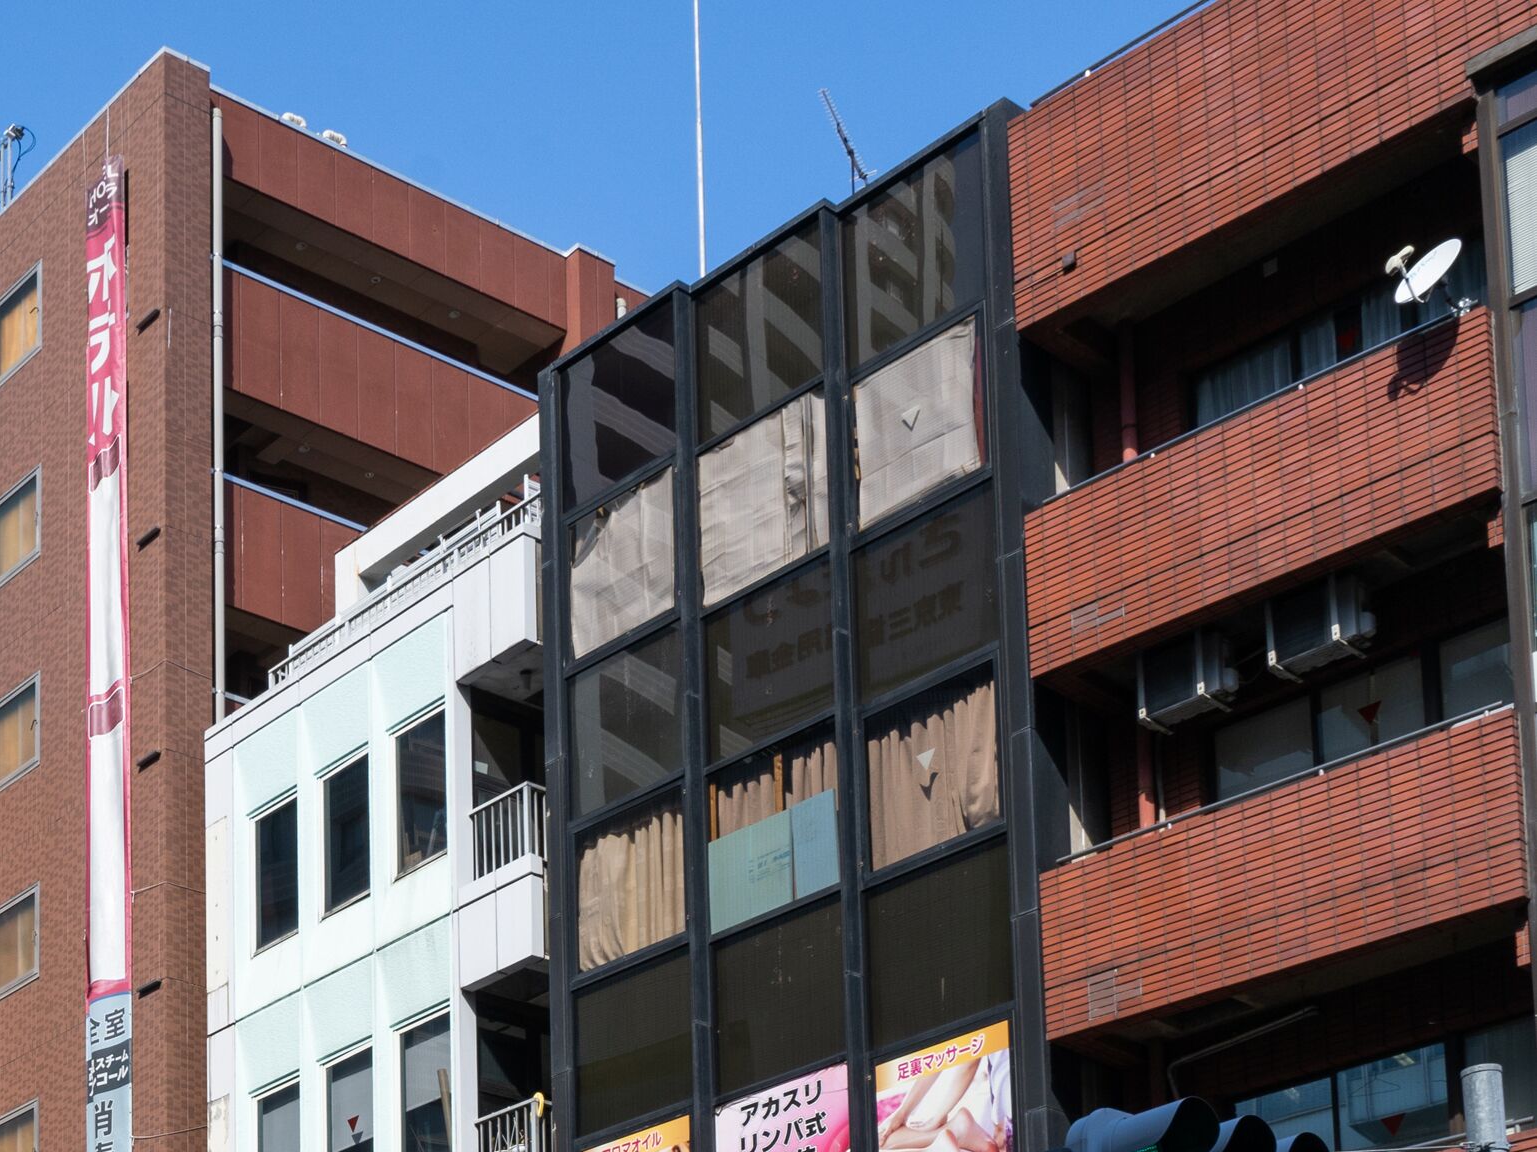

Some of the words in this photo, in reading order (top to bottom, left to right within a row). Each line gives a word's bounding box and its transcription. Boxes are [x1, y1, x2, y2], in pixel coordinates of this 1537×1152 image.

[897, 1035, 985, 1081] 足裏マッサージ
[740, 1080, 822, 1126] アカスリ
